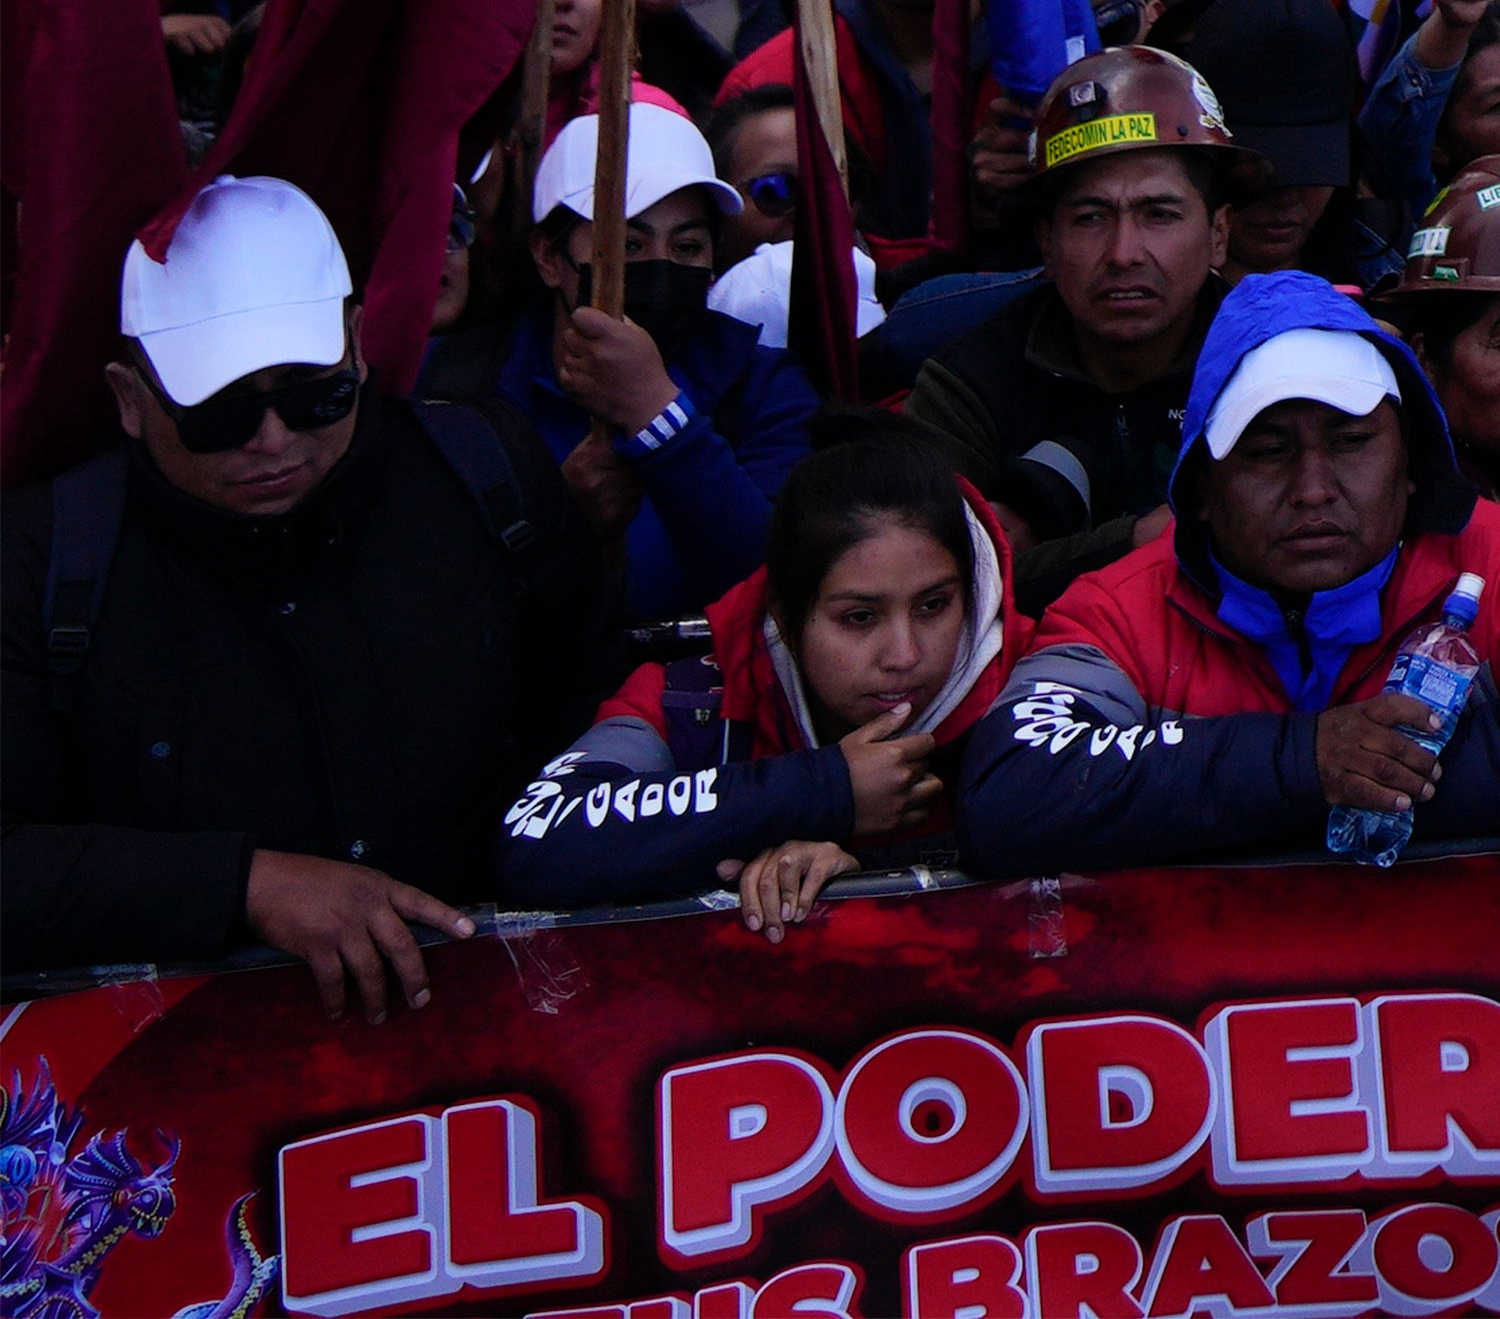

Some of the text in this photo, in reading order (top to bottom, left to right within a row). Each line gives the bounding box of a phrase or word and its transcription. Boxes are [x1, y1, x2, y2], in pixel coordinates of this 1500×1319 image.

[1048, 118, 1151, 163] FEDECOMIN LA PAZ
[276, 1095, 612, 1318] EL
